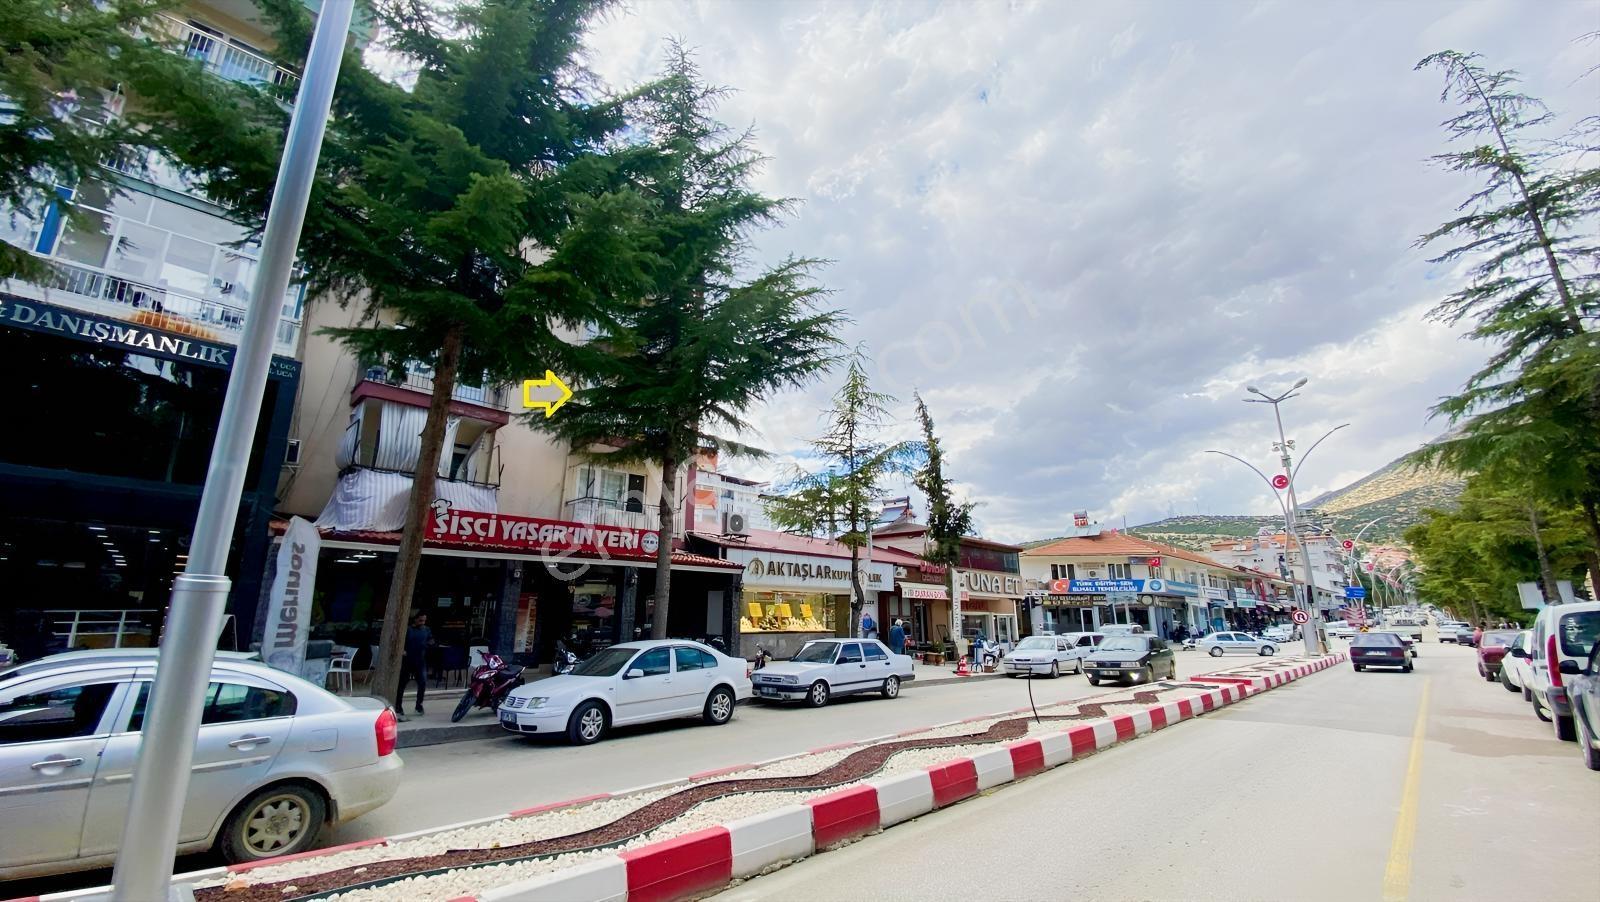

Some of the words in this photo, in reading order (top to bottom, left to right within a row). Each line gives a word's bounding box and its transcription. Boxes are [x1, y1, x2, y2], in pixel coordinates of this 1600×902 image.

[10, 303, 230, 366] DANIŞMANLIK
[433, 510, 497, 541] ŞİŞÇİ
[500, 519, 594, 546] YAŞAR'IN
[595, 530, 640, 550] YERİ
[766, 560, 832, 582] AKTAŞLAR
[1003, 575, 1021, 595] ET
